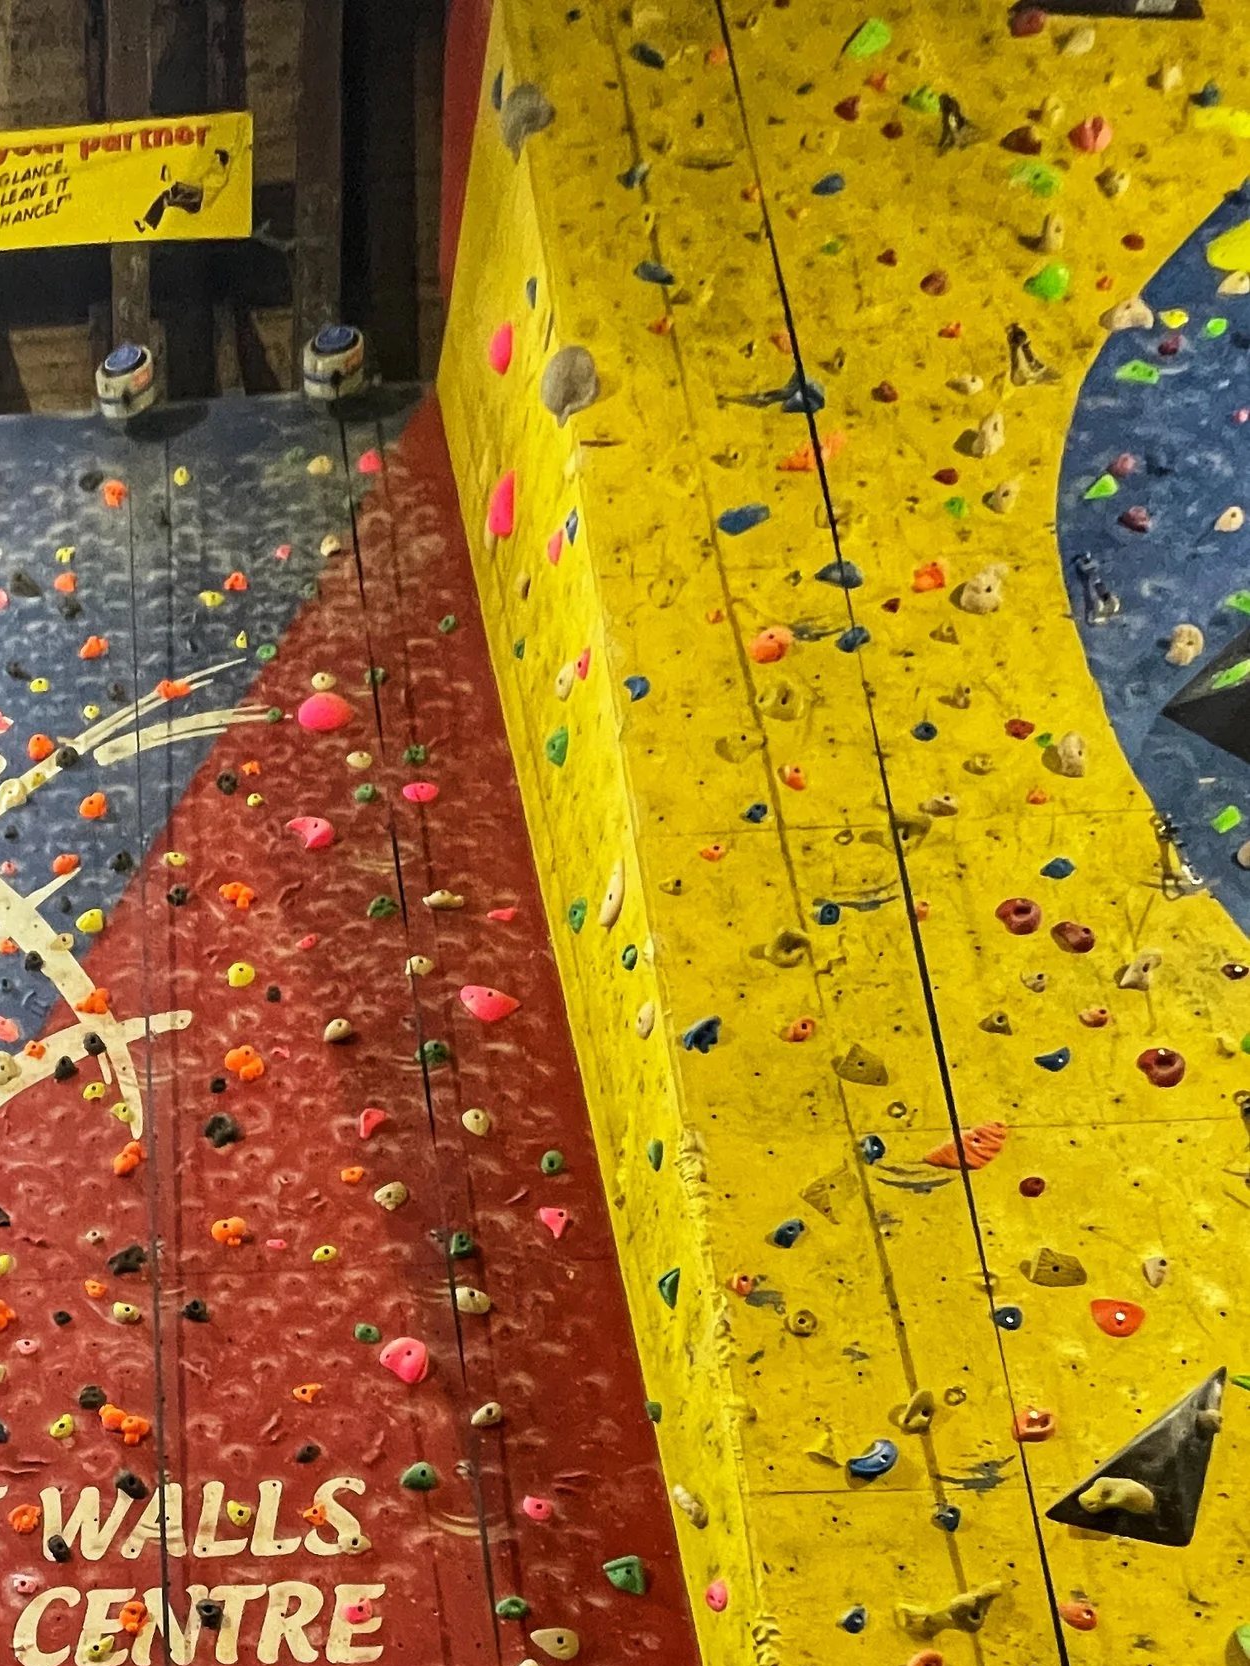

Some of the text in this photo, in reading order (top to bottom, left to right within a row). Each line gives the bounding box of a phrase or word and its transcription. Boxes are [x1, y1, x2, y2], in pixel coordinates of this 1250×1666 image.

[0, 180, 49, 207] LEAVE
[56, 176, 71, 192] IT
[38, 1477, 367, 1565] WALLS
